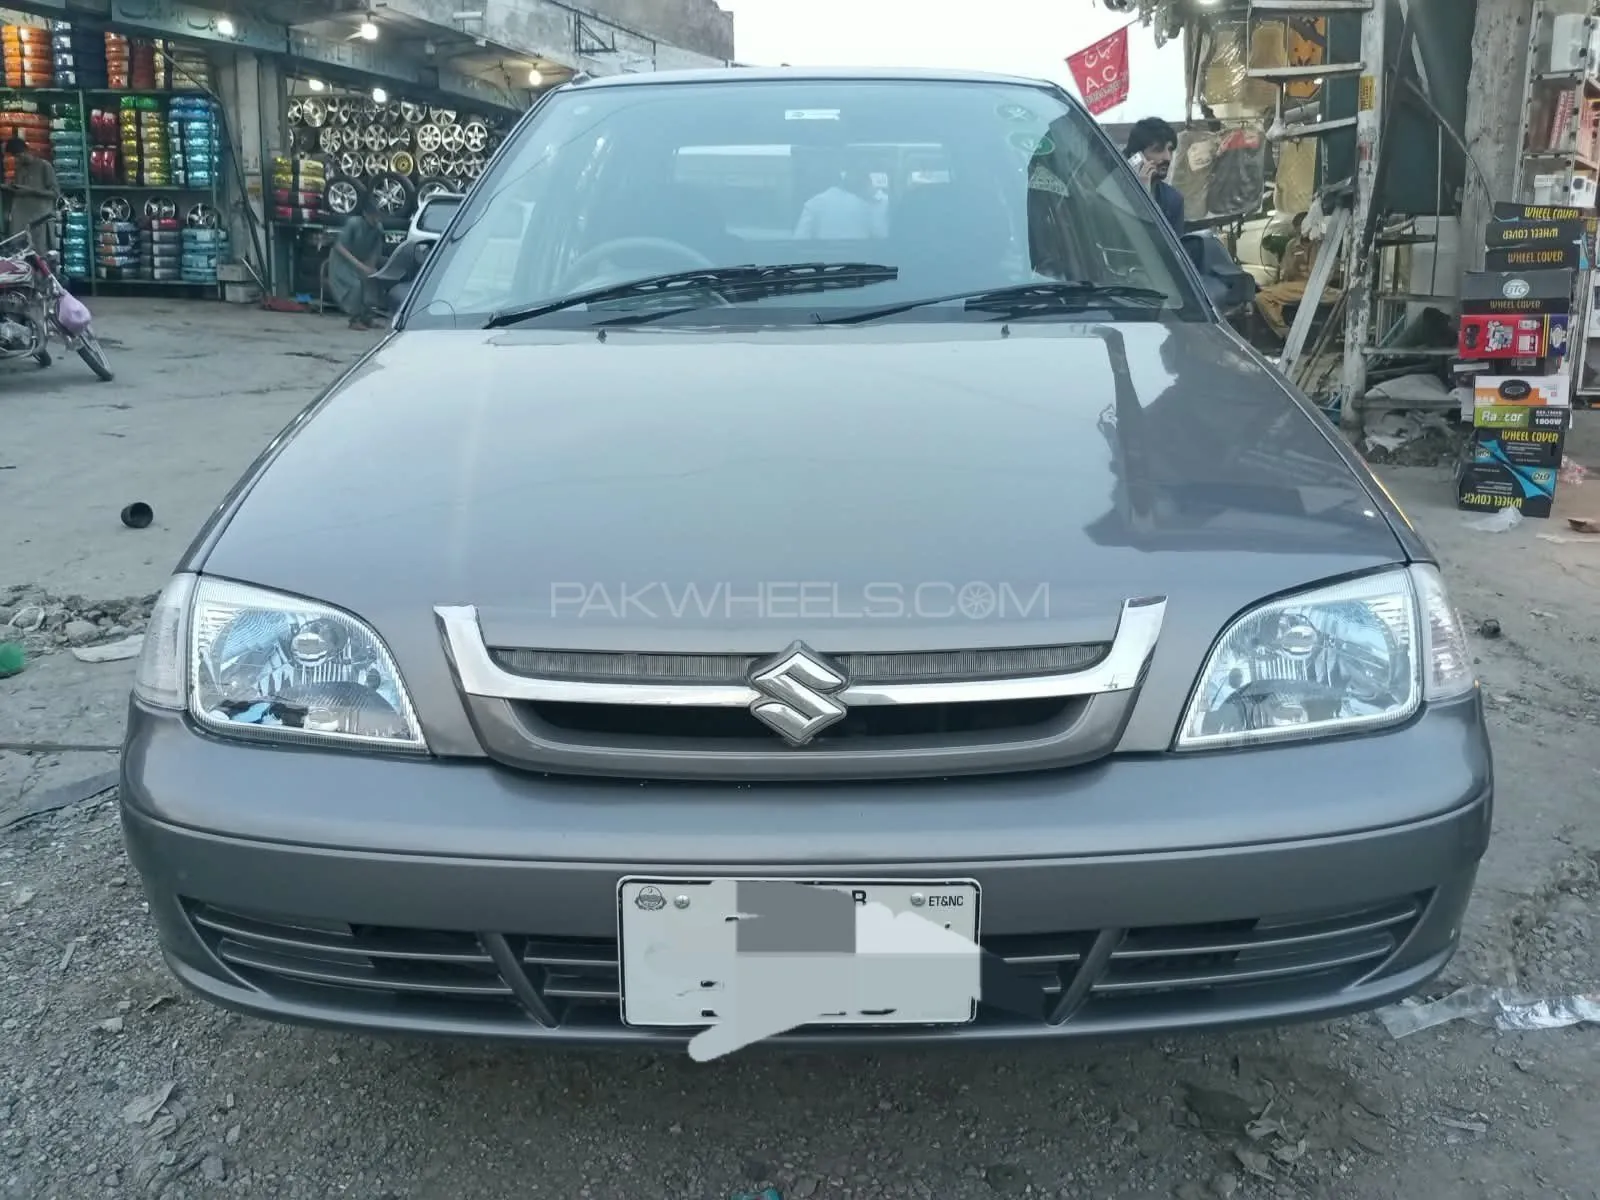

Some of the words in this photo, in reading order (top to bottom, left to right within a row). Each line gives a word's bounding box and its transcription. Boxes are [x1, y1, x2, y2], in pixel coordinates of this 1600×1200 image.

[1085, 65, 1118, 94] A.C
[1524, 206, 1551, 219] WHEEL
[1552, 208, 1579, 219] COVER
[1503, 230, 1528, 240] COVER
[1531, 228, 1558, 238] WHEEL
[1508, 252, 1535, 263] WHEEL
[1537, 251, 1563, 262] COVER
[1490, 300, 1515, 309] WHEEL
[1517, 300, 1541, 309] COVER
[1501, 430, 1529, 441] WHEEL
[1531, 431, 1559, 442] COVER
[1463, 492, 1491, 506] COVER
[1494, 496, 1522, 509] WHEEL
[928, 895, 964, 907] ET&NC
